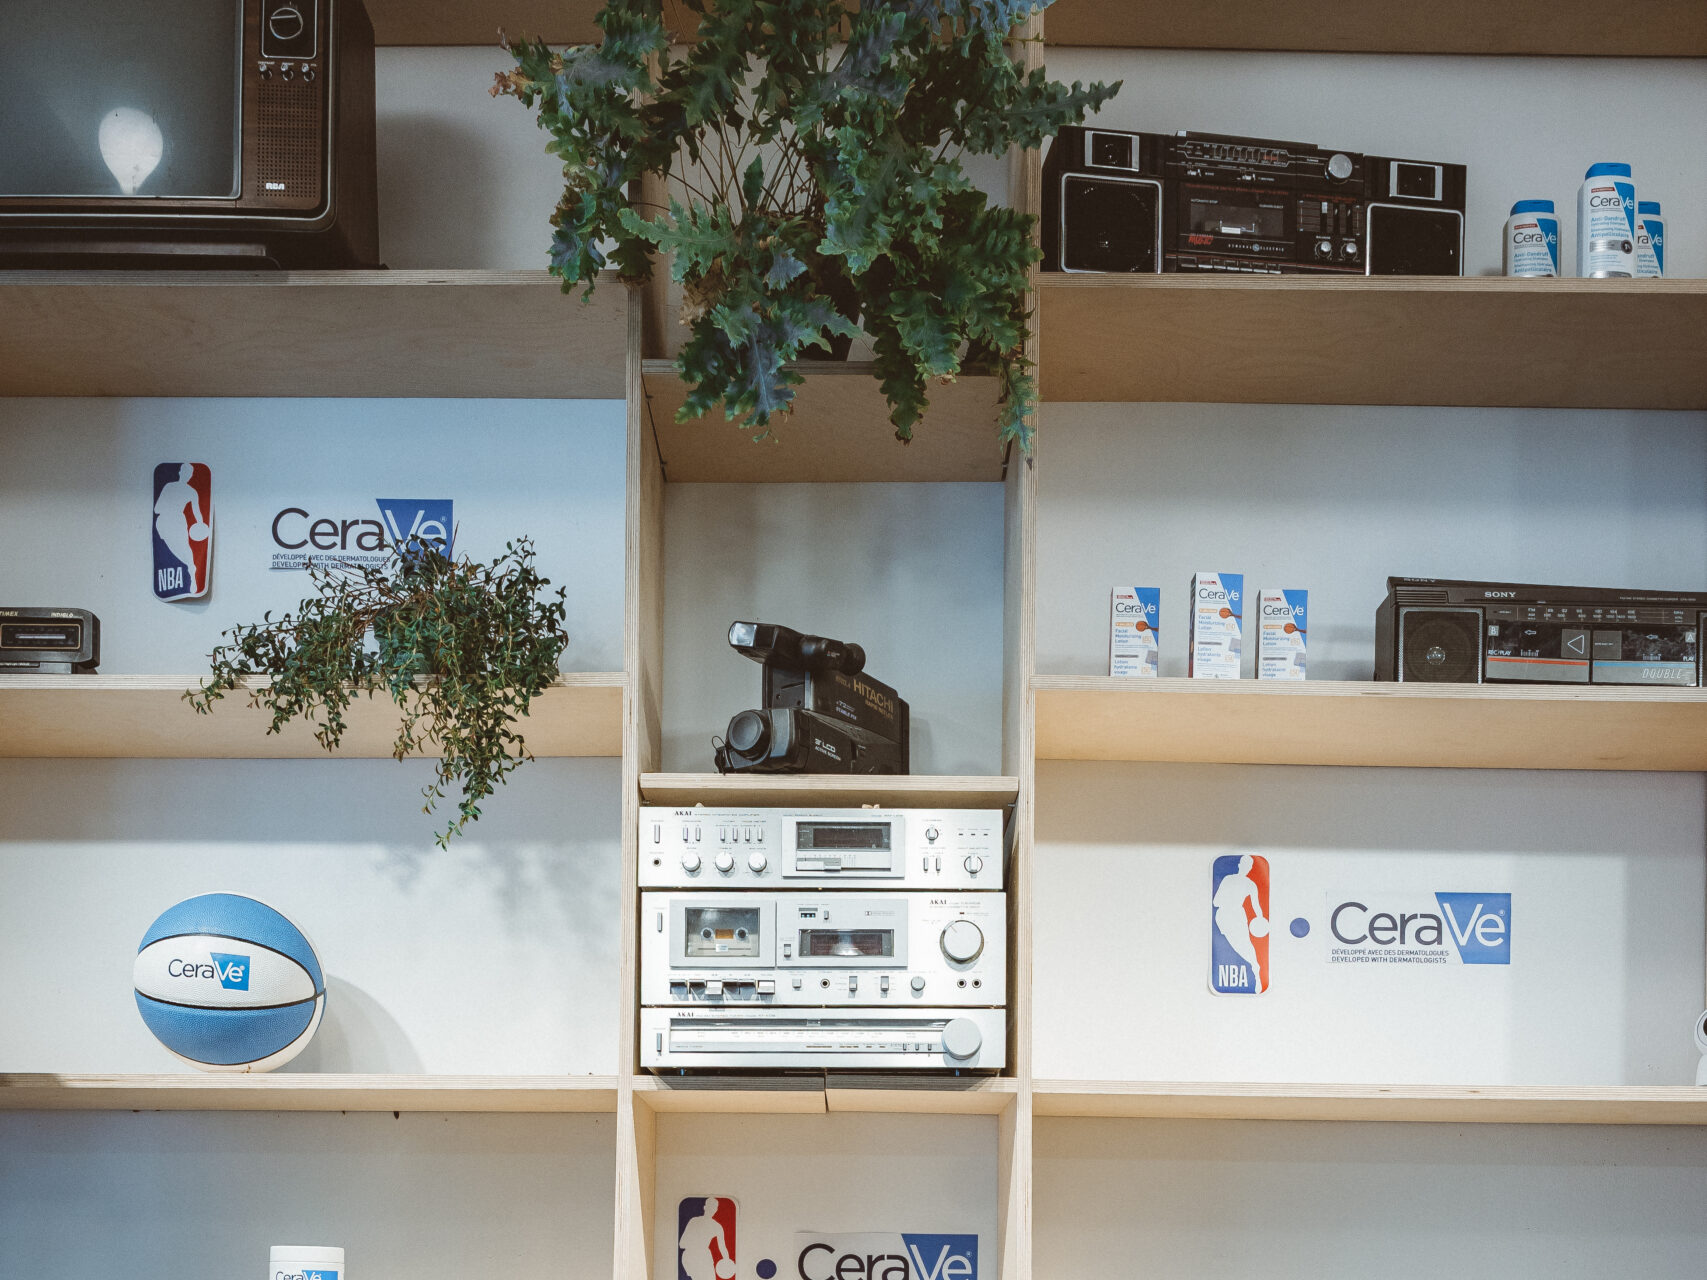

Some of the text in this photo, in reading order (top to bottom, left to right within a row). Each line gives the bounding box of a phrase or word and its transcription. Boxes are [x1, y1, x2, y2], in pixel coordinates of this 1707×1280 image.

[265, 182, 285, 191] RCA
[1590, 195, 1634, 210] CeraVe
[1513, 231, 1557, 244] CeraVe
[1637, 233, 1663, 246] raVe
[271, 507, 448, 555] CeraVe
[158, 567, 184, 592] NBA
[1198, 588, 1240, 600] CeraVe
[1115, 602, 1156, 614] CeraVe
[1263, 604, 1304, 616] CeraVe
[853, 678, 894, 714] HITACHI
[1330, 901, 1506, 947] CeraVe
[1396, 949, 1450, 957] DERMATOLOGUES
[168, 959, 243, 983] CeraVe
[1218, 964, 1249, 988] NBA
